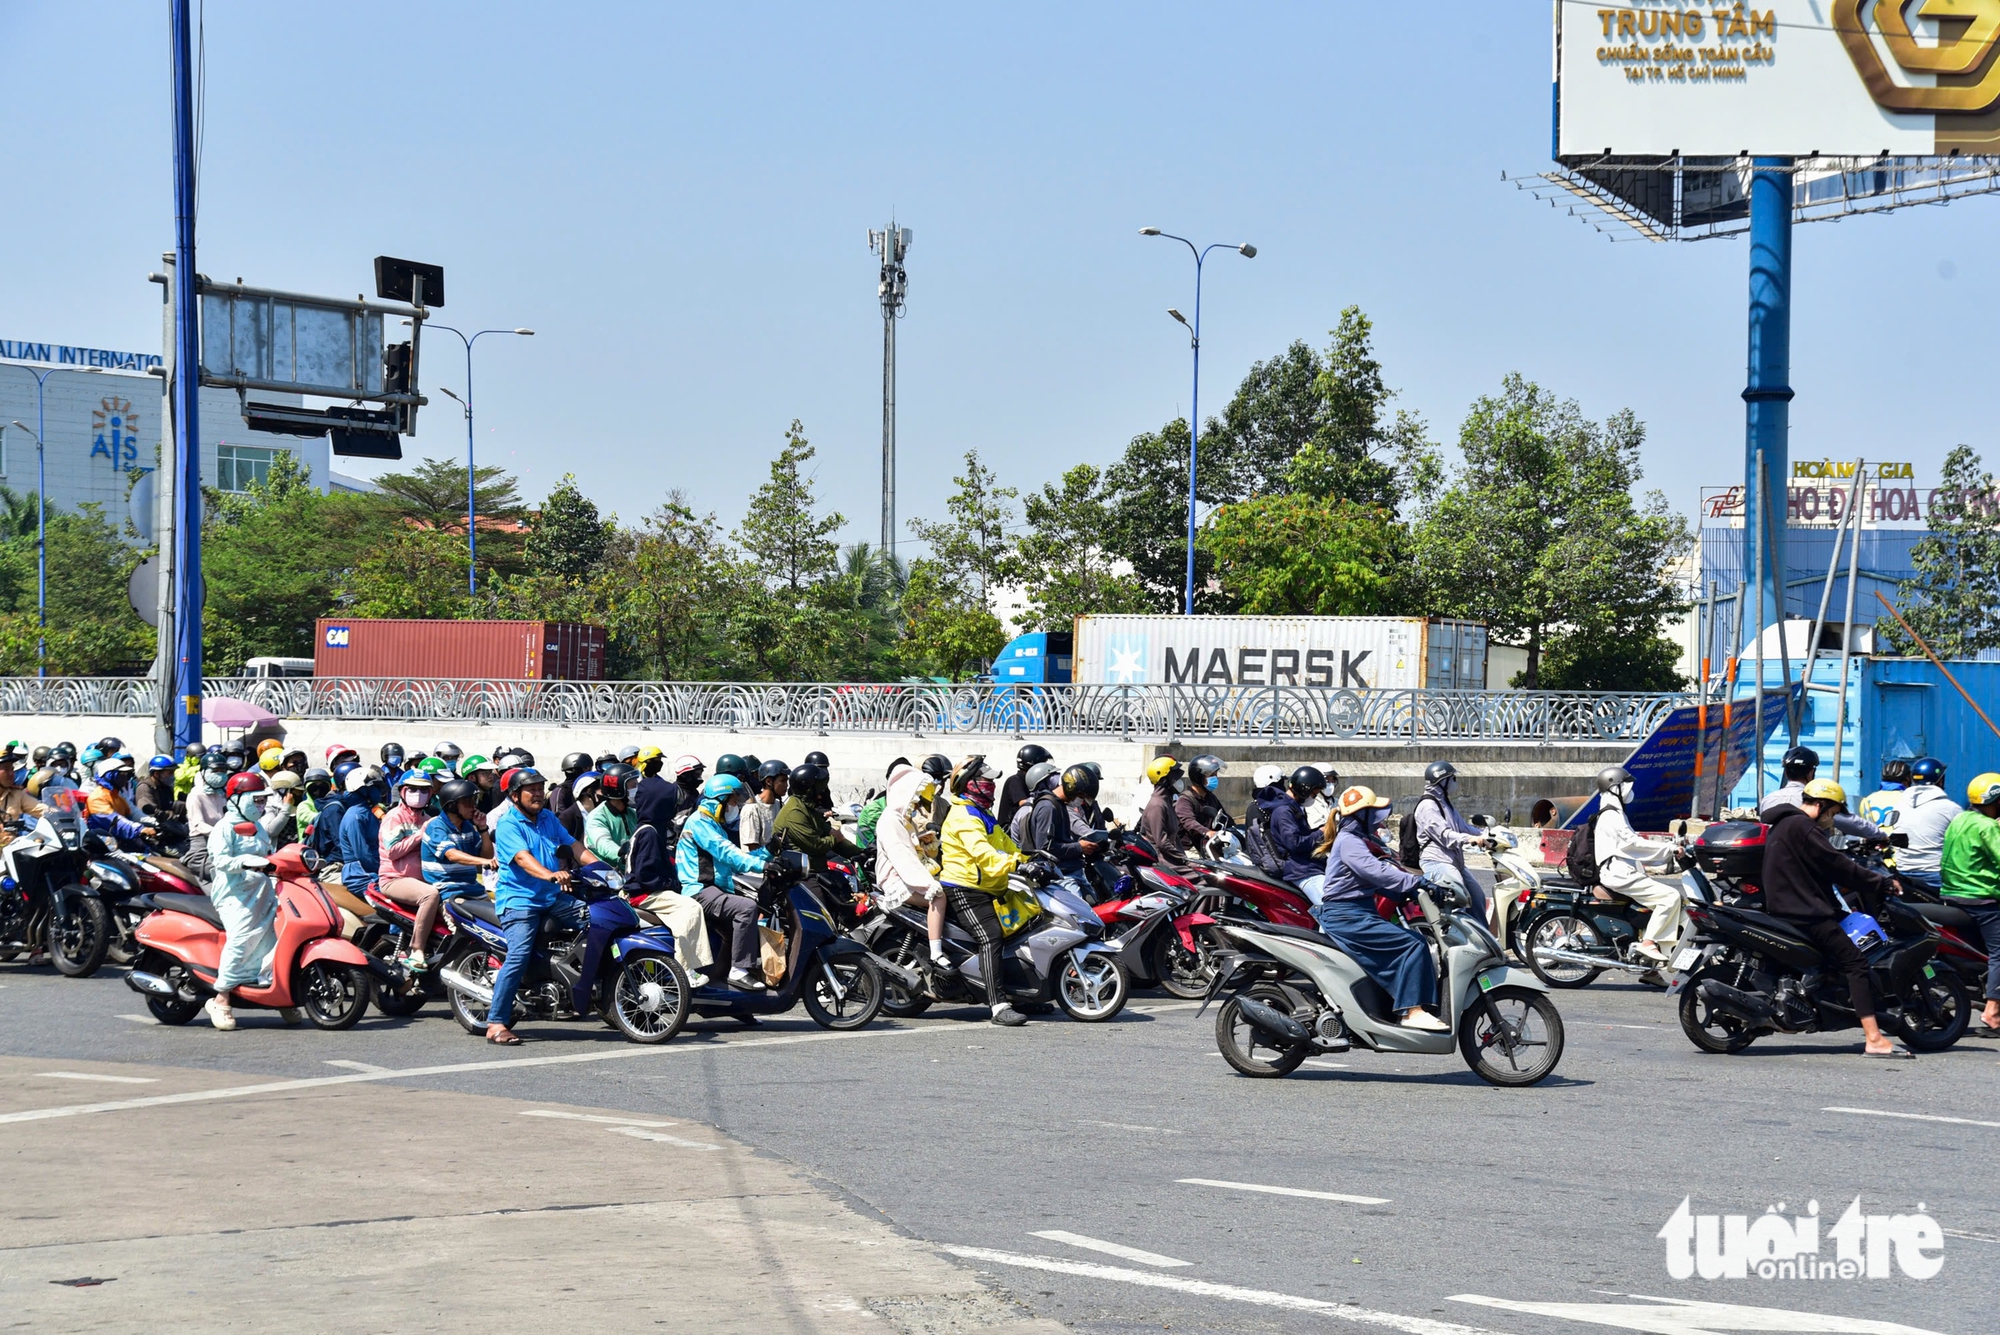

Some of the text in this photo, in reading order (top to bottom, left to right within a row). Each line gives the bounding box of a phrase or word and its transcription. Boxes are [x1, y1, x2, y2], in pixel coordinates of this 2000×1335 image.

[1597, 2, 1774, 36] TRUNG TÂM
[1653, 43, 1694, 61] SỐNG
[1698, 44, 1737, 60] TOÀN
[1742, 42, 1773, 60] CẦU
[1668, 64, 1685, 78] HỒ
[1688, 65, 1708, 78] CHÍ
[1713, 67, 1745, 78] MINH
[1878, 462, 1914, 479] GIA
[1870, 488, 1920, 521] HOA
[1164, 647, 1373, 688] MAERSK
